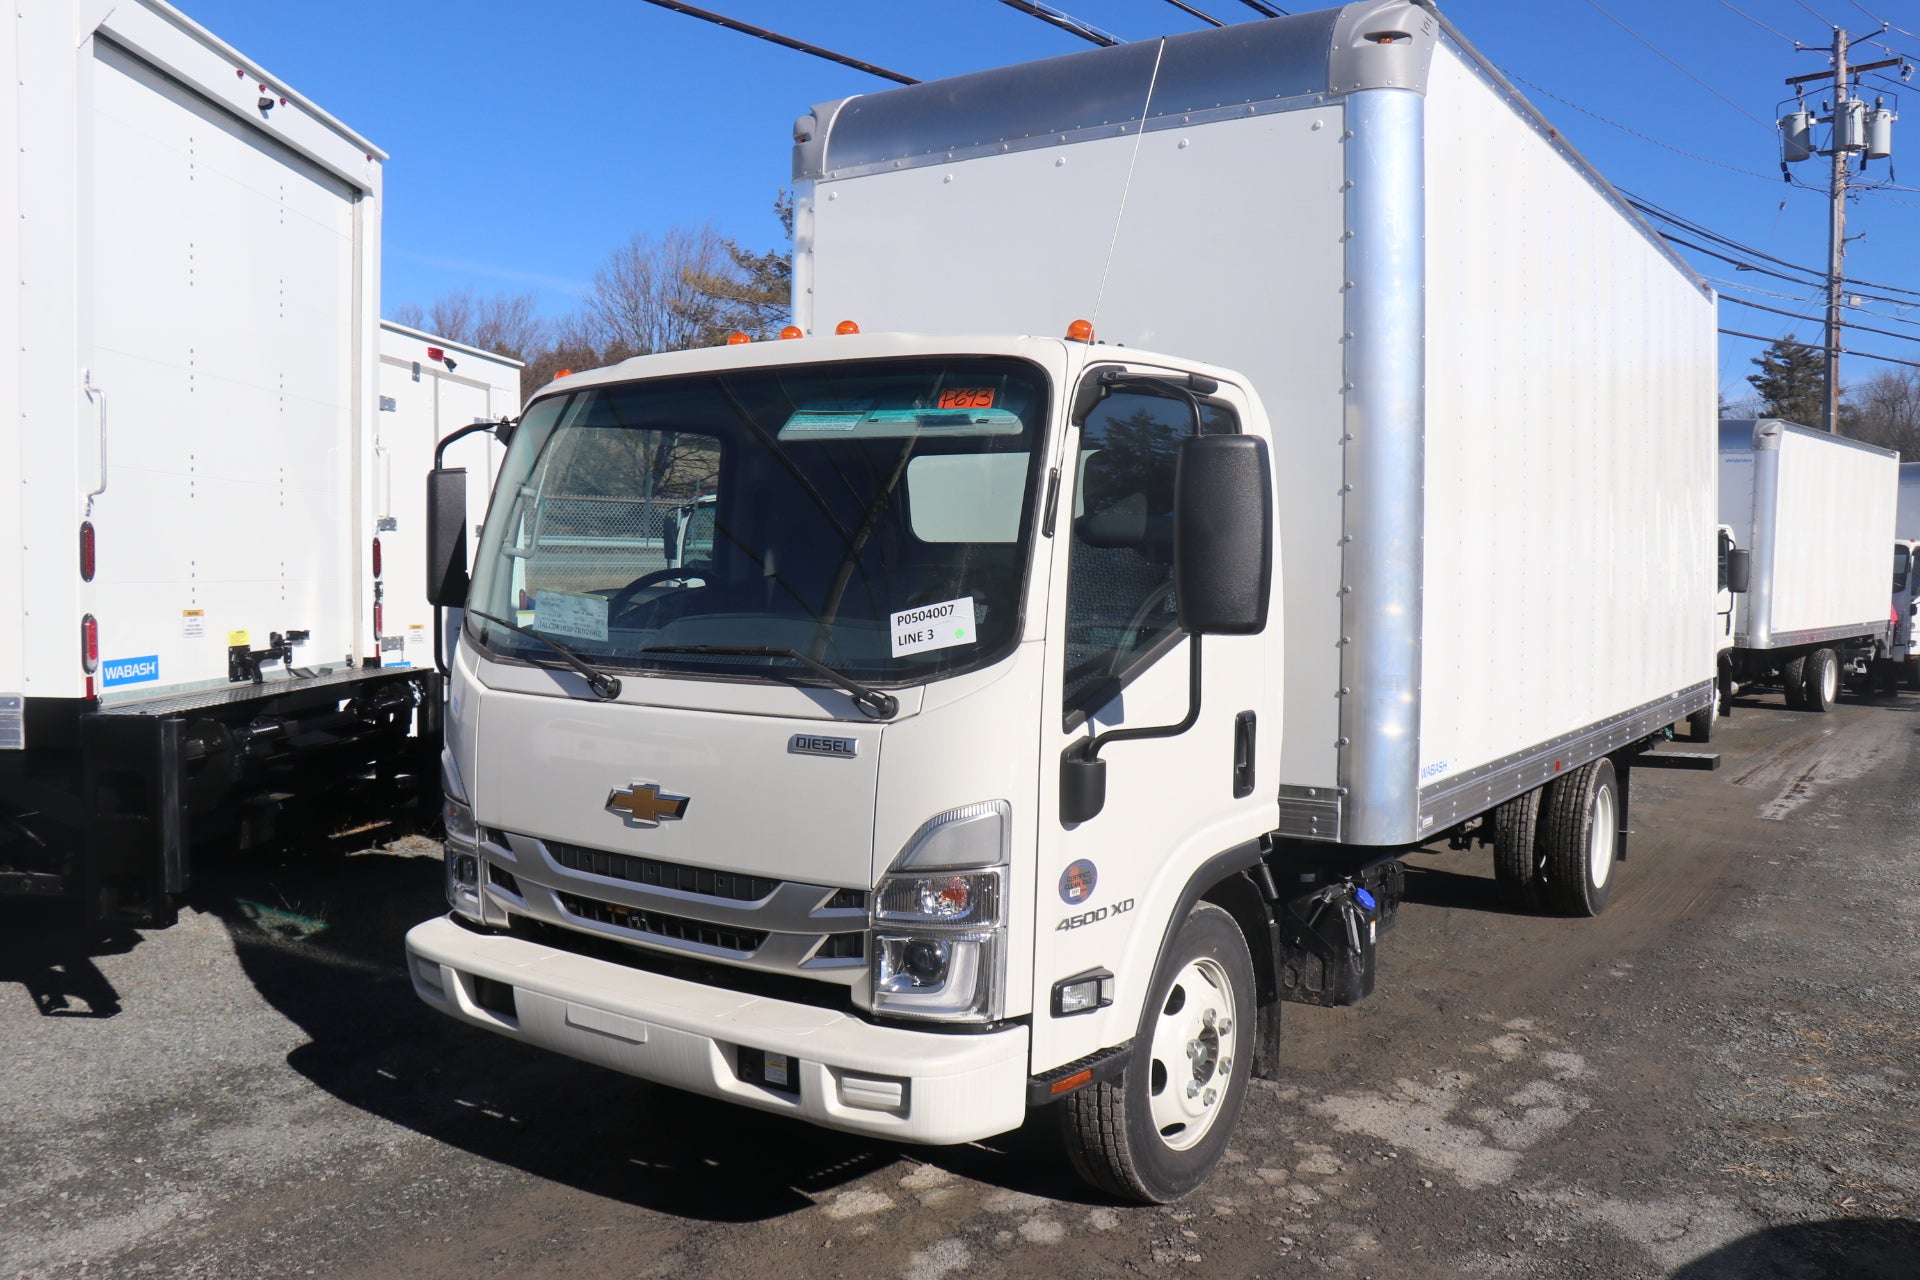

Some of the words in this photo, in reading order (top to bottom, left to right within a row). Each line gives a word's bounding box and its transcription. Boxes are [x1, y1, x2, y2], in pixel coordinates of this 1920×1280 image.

[941, 388, 991, 409] P693
[897, 604, 955, 627] P0504007
[898, 631, 924, 646] LINE
[927, 629, 935, 640] 3
[104, 661, 156, 681] WABASH
[795, 736, 852, 753] DIESEL
[1420, 760, 1448, 779] WABASH
[1055, 907, 1108, 932] 4500
[1111, 898, 1135, 917] XD
